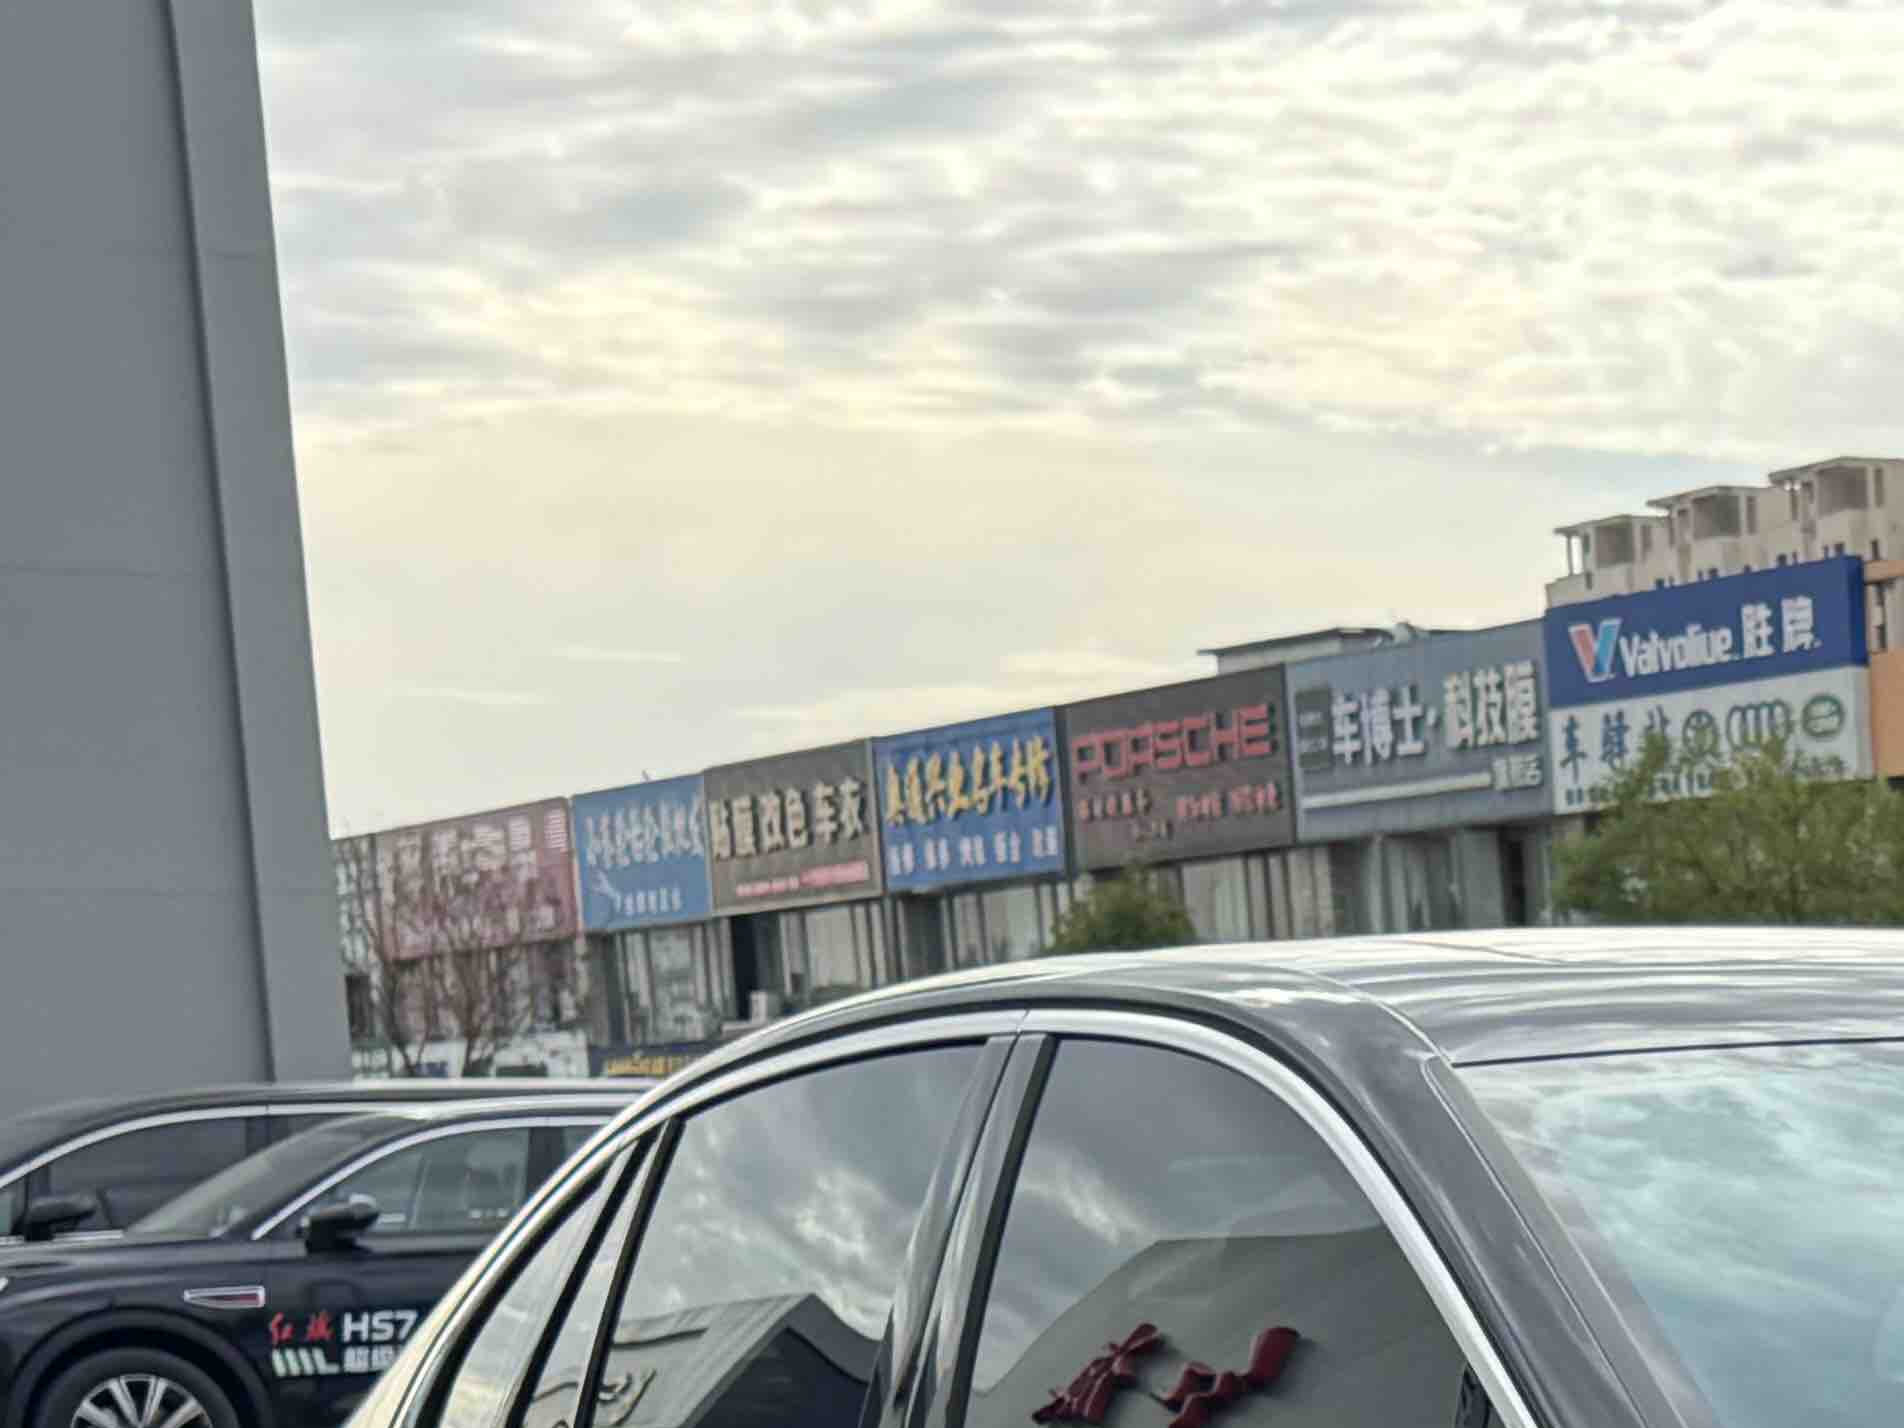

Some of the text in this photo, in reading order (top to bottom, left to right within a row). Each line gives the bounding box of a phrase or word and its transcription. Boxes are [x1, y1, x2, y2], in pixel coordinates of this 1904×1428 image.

[1619, 596, 1815, 678] Valvoline 胜牌
[1071, 703, 1271, 776] PORSCHE
[343, 1309, 418, 1342] HS7
